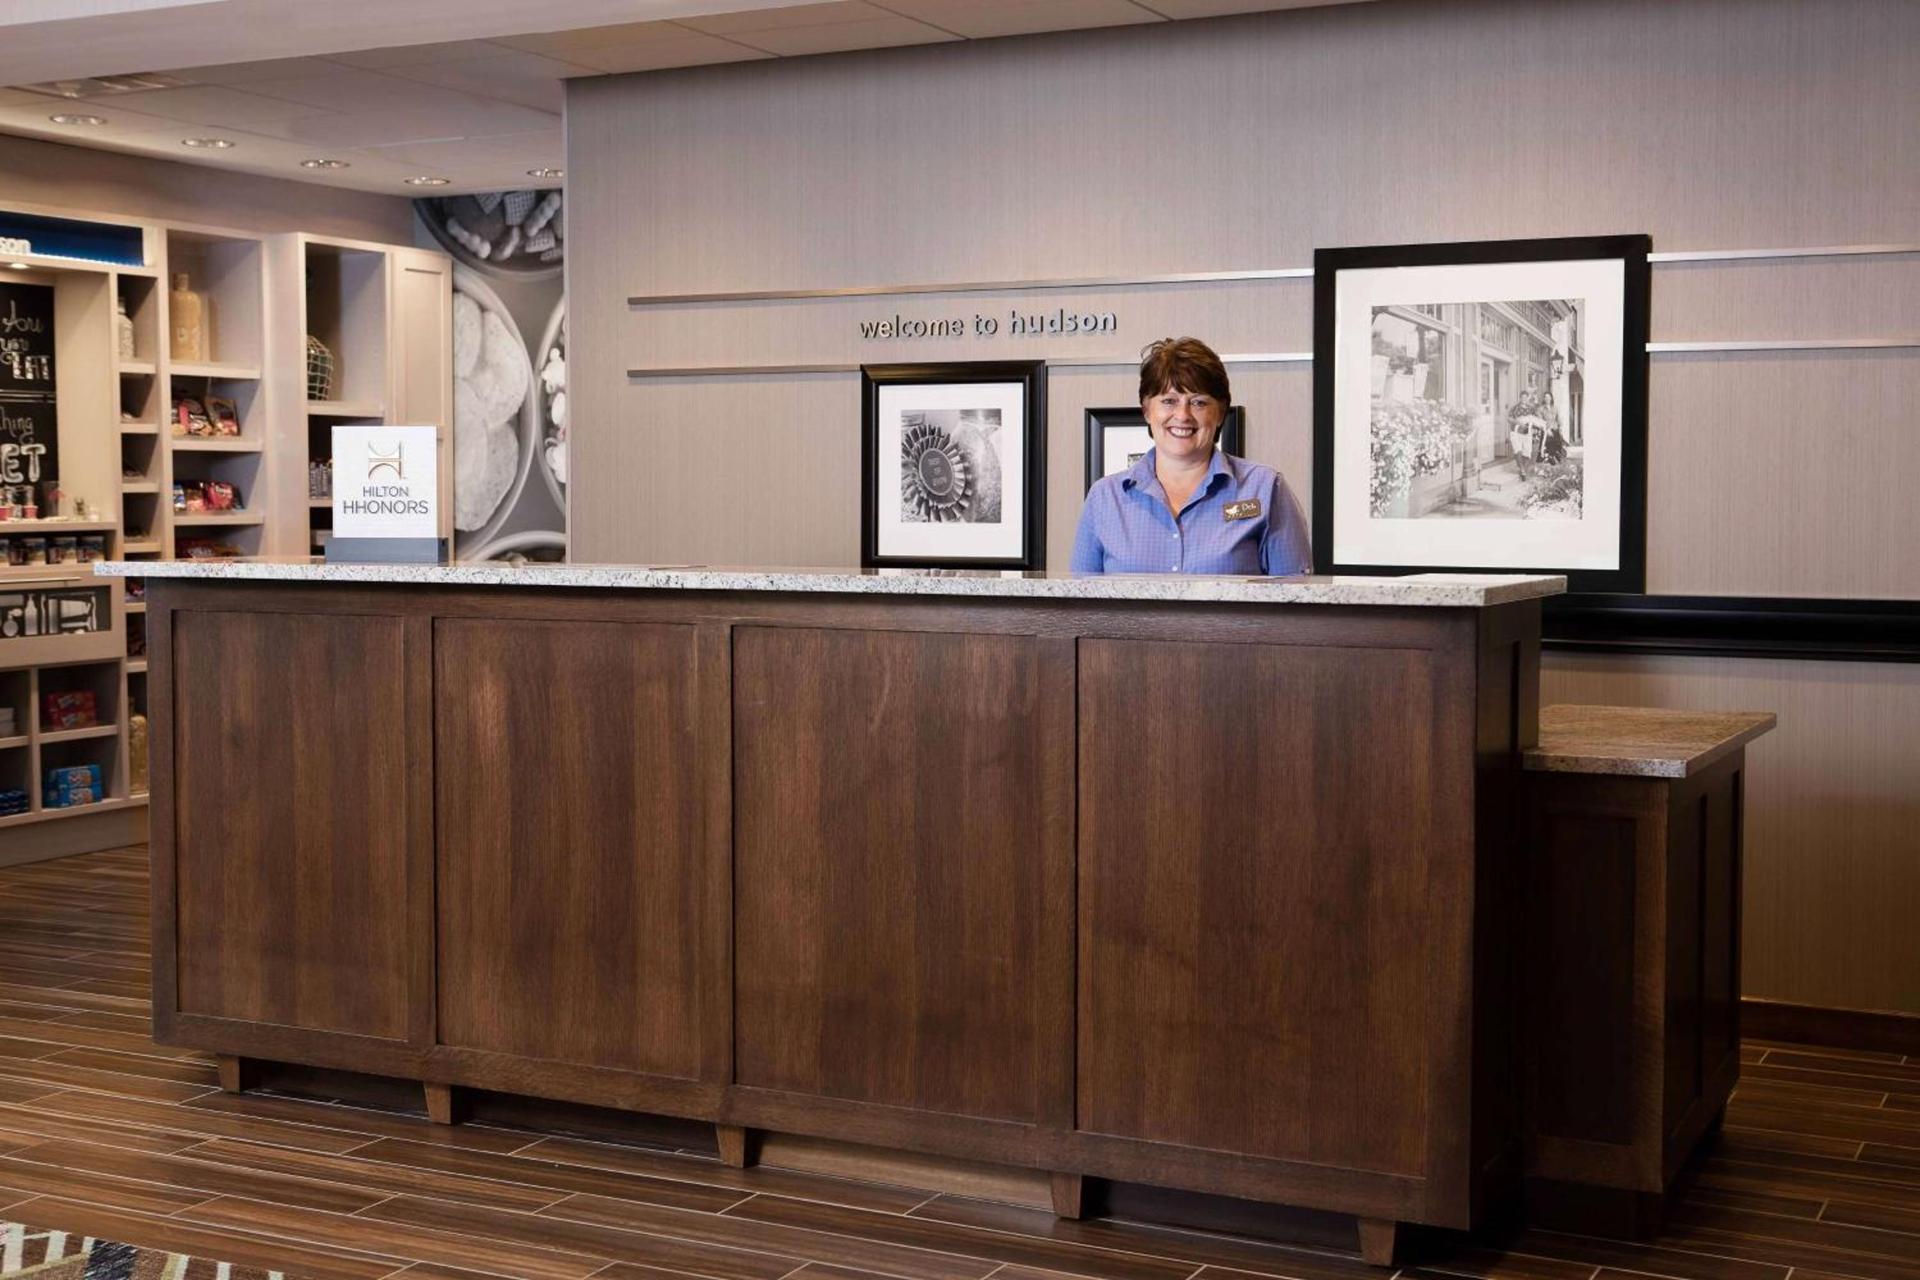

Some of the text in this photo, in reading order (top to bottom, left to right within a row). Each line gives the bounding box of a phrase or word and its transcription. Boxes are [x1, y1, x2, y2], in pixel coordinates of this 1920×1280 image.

[860, 308, 1117, 339] welcome to hudson
[362, 485, 409, 497] HILTON
[343, 499, 429, 514] HHONORS
